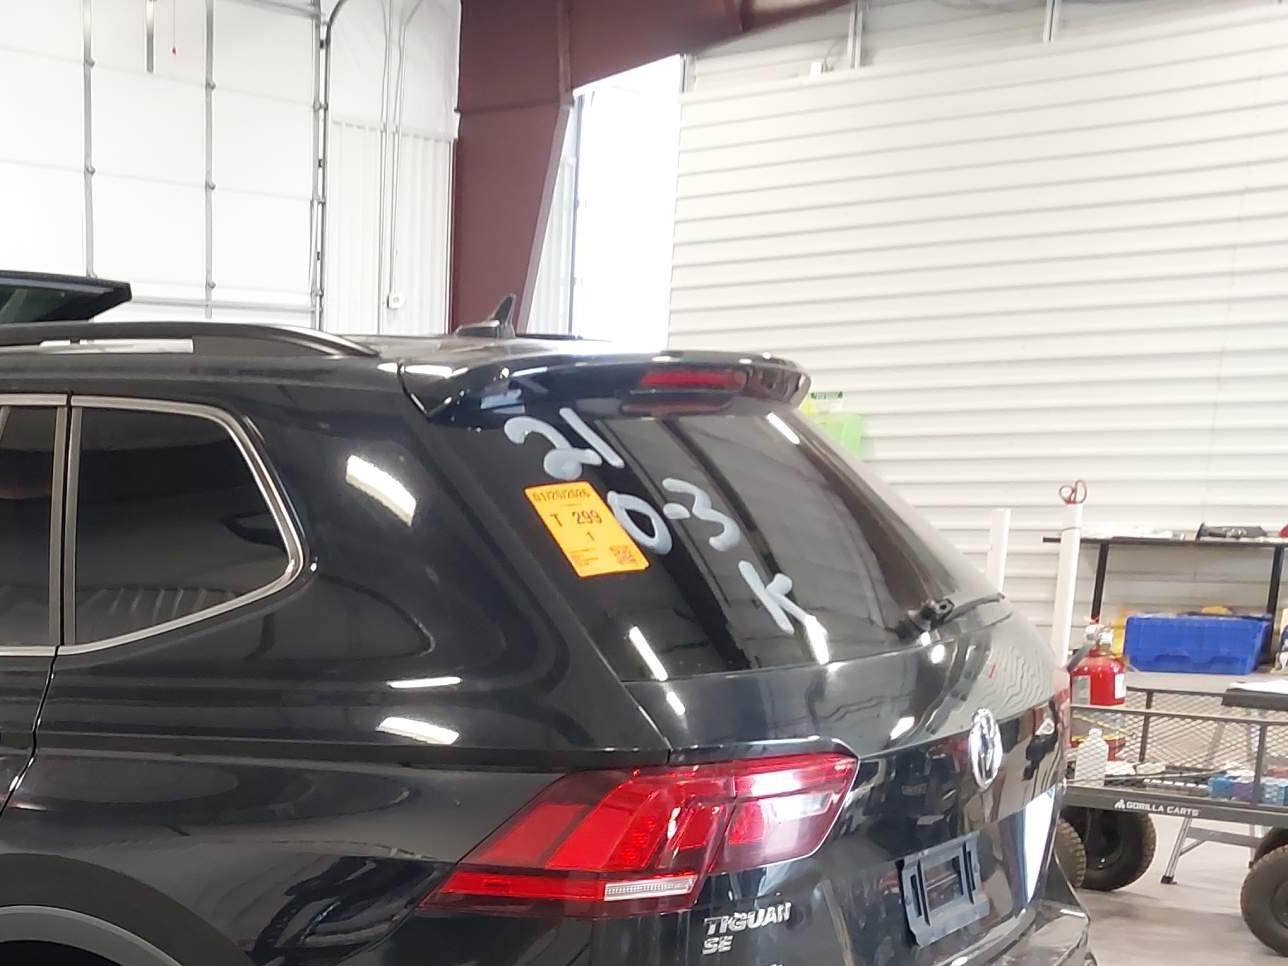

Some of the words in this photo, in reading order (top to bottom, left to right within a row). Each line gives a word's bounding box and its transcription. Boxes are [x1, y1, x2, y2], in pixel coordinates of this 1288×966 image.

[550, 513, 563, 528] T
[572, 509, 604, 525] 299
[1126, 801, 1165, 812] GORILLA
[1166, 806, 1199, 817] CARTS
[703, 901, 792, 936] TIGUAN
[702, 935, 734, 956] SE
